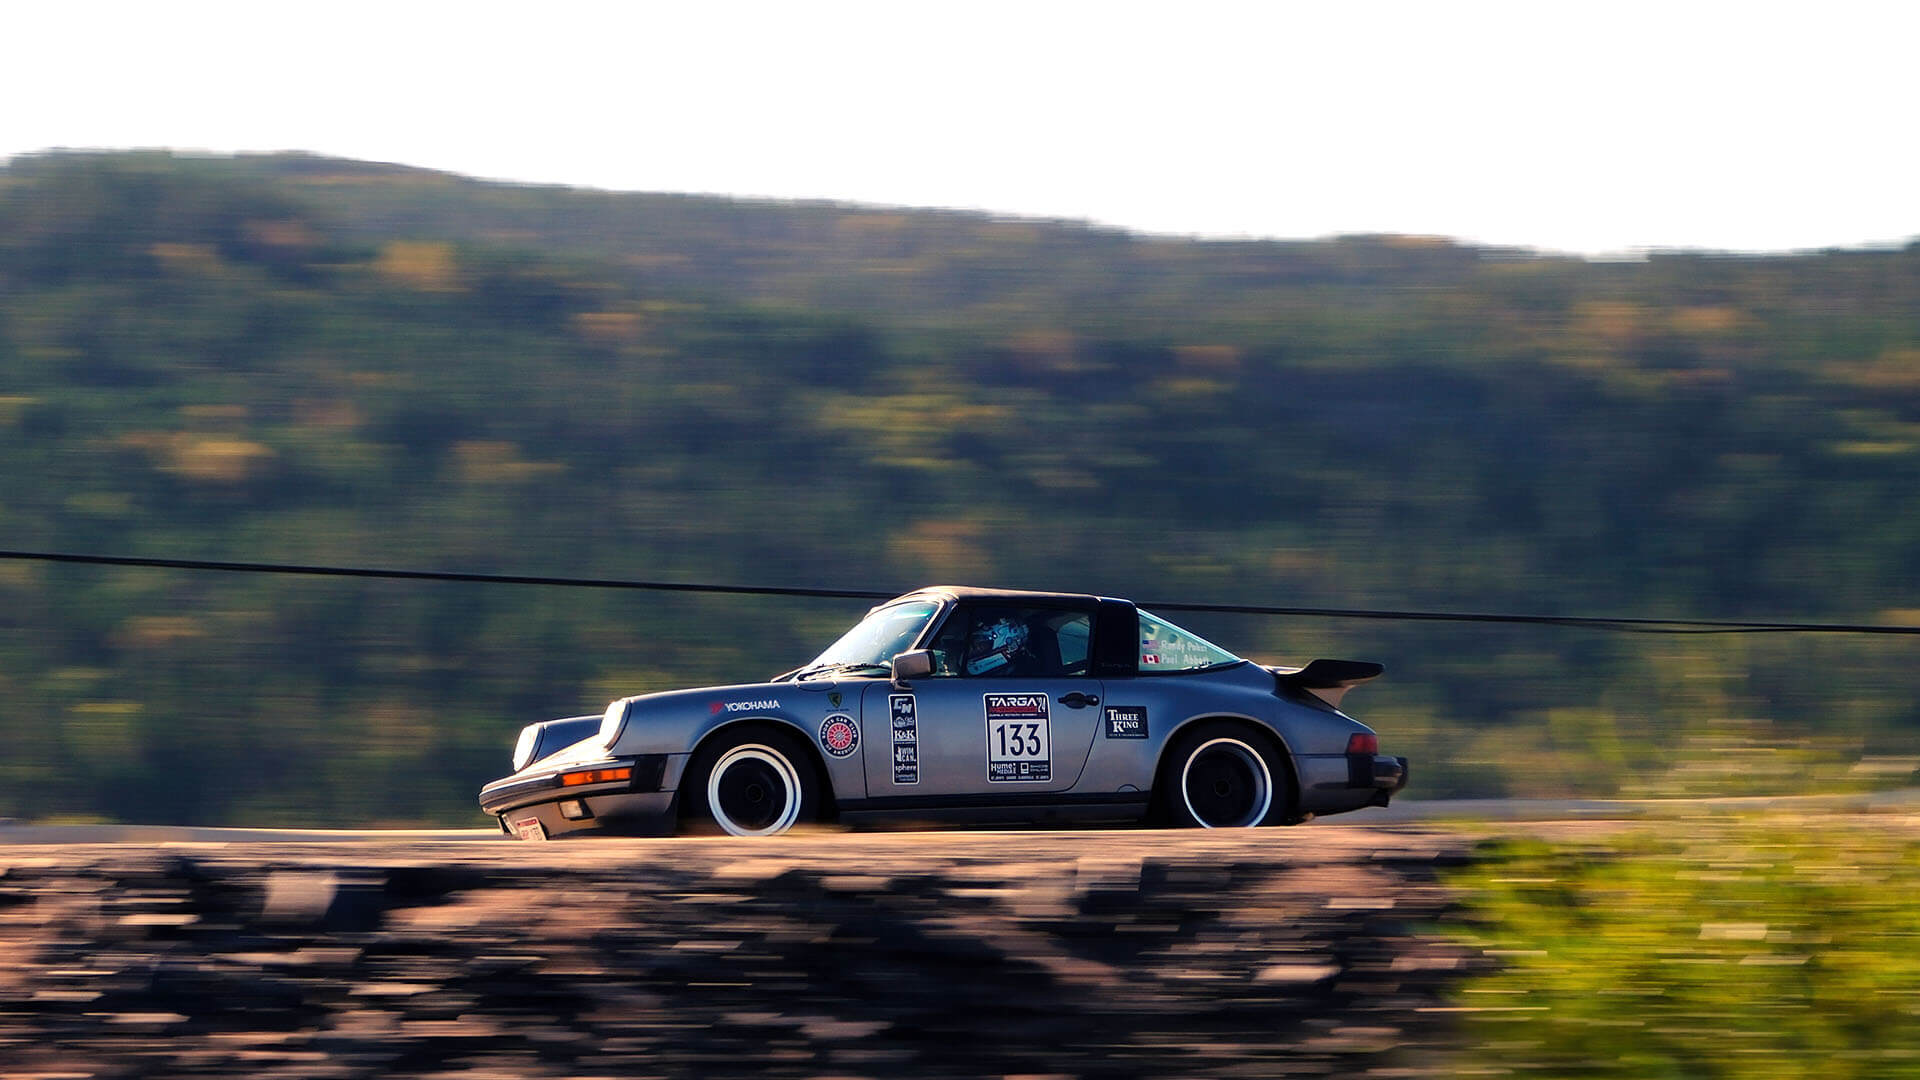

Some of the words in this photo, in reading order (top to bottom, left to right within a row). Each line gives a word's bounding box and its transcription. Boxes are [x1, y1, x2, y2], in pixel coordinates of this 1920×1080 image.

[725, 700, 780, 711] YOKOHAMA
[989, 697, 1037, 707] TARGA
[997, 724, 1041, 756] 133
